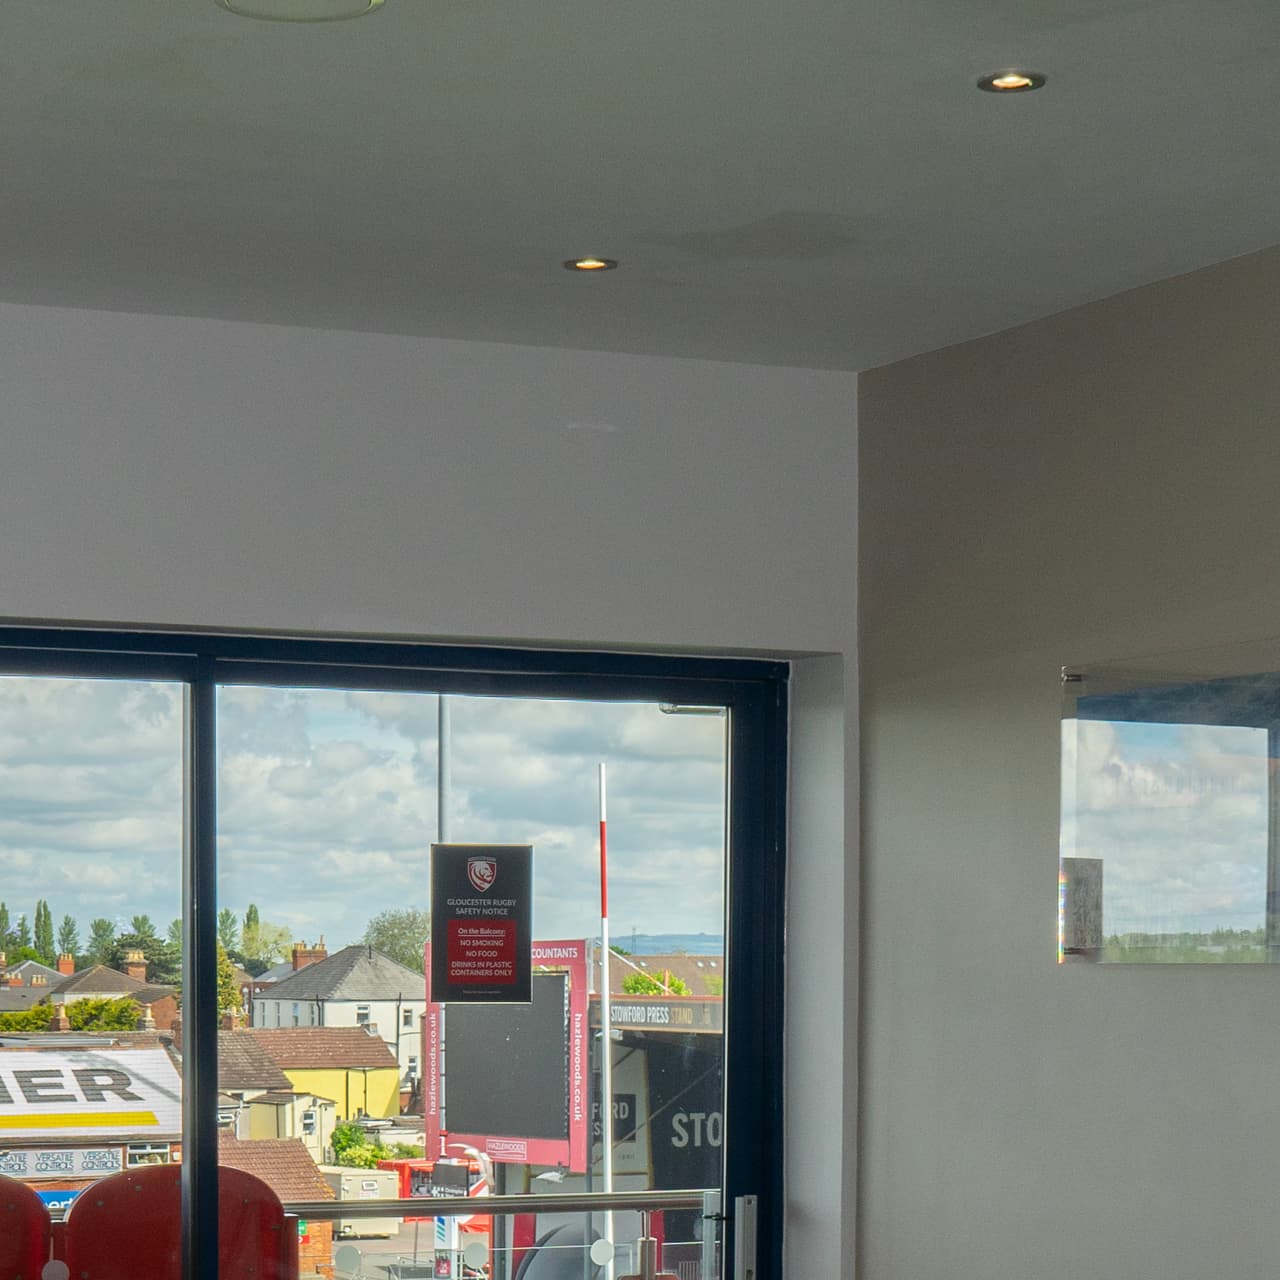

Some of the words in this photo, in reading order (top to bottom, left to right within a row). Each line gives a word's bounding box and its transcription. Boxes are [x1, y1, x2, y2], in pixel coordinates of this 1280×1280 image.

[447, 898, 490, 906] GLOUCESTER
[493, 898, 517, 906] RUGBY
[455, 907, 480, 915] SAFETY
[482, 907, 508, 916] NOTICE
[457, 927, 467, 935] On
[468, 927, 479, 935] the
[460, 939, 471, 947] NO
[472, 939, 504, 947] SMOKING
[611, 1005, 646, 1023] STOWFORD
[647, 1006, 670, 1024] PRESS
[429, 1013, 437, 1115] hazlewoods.co.uk
[574, 1013, 583, 1121] hazlewoods.co.uk
